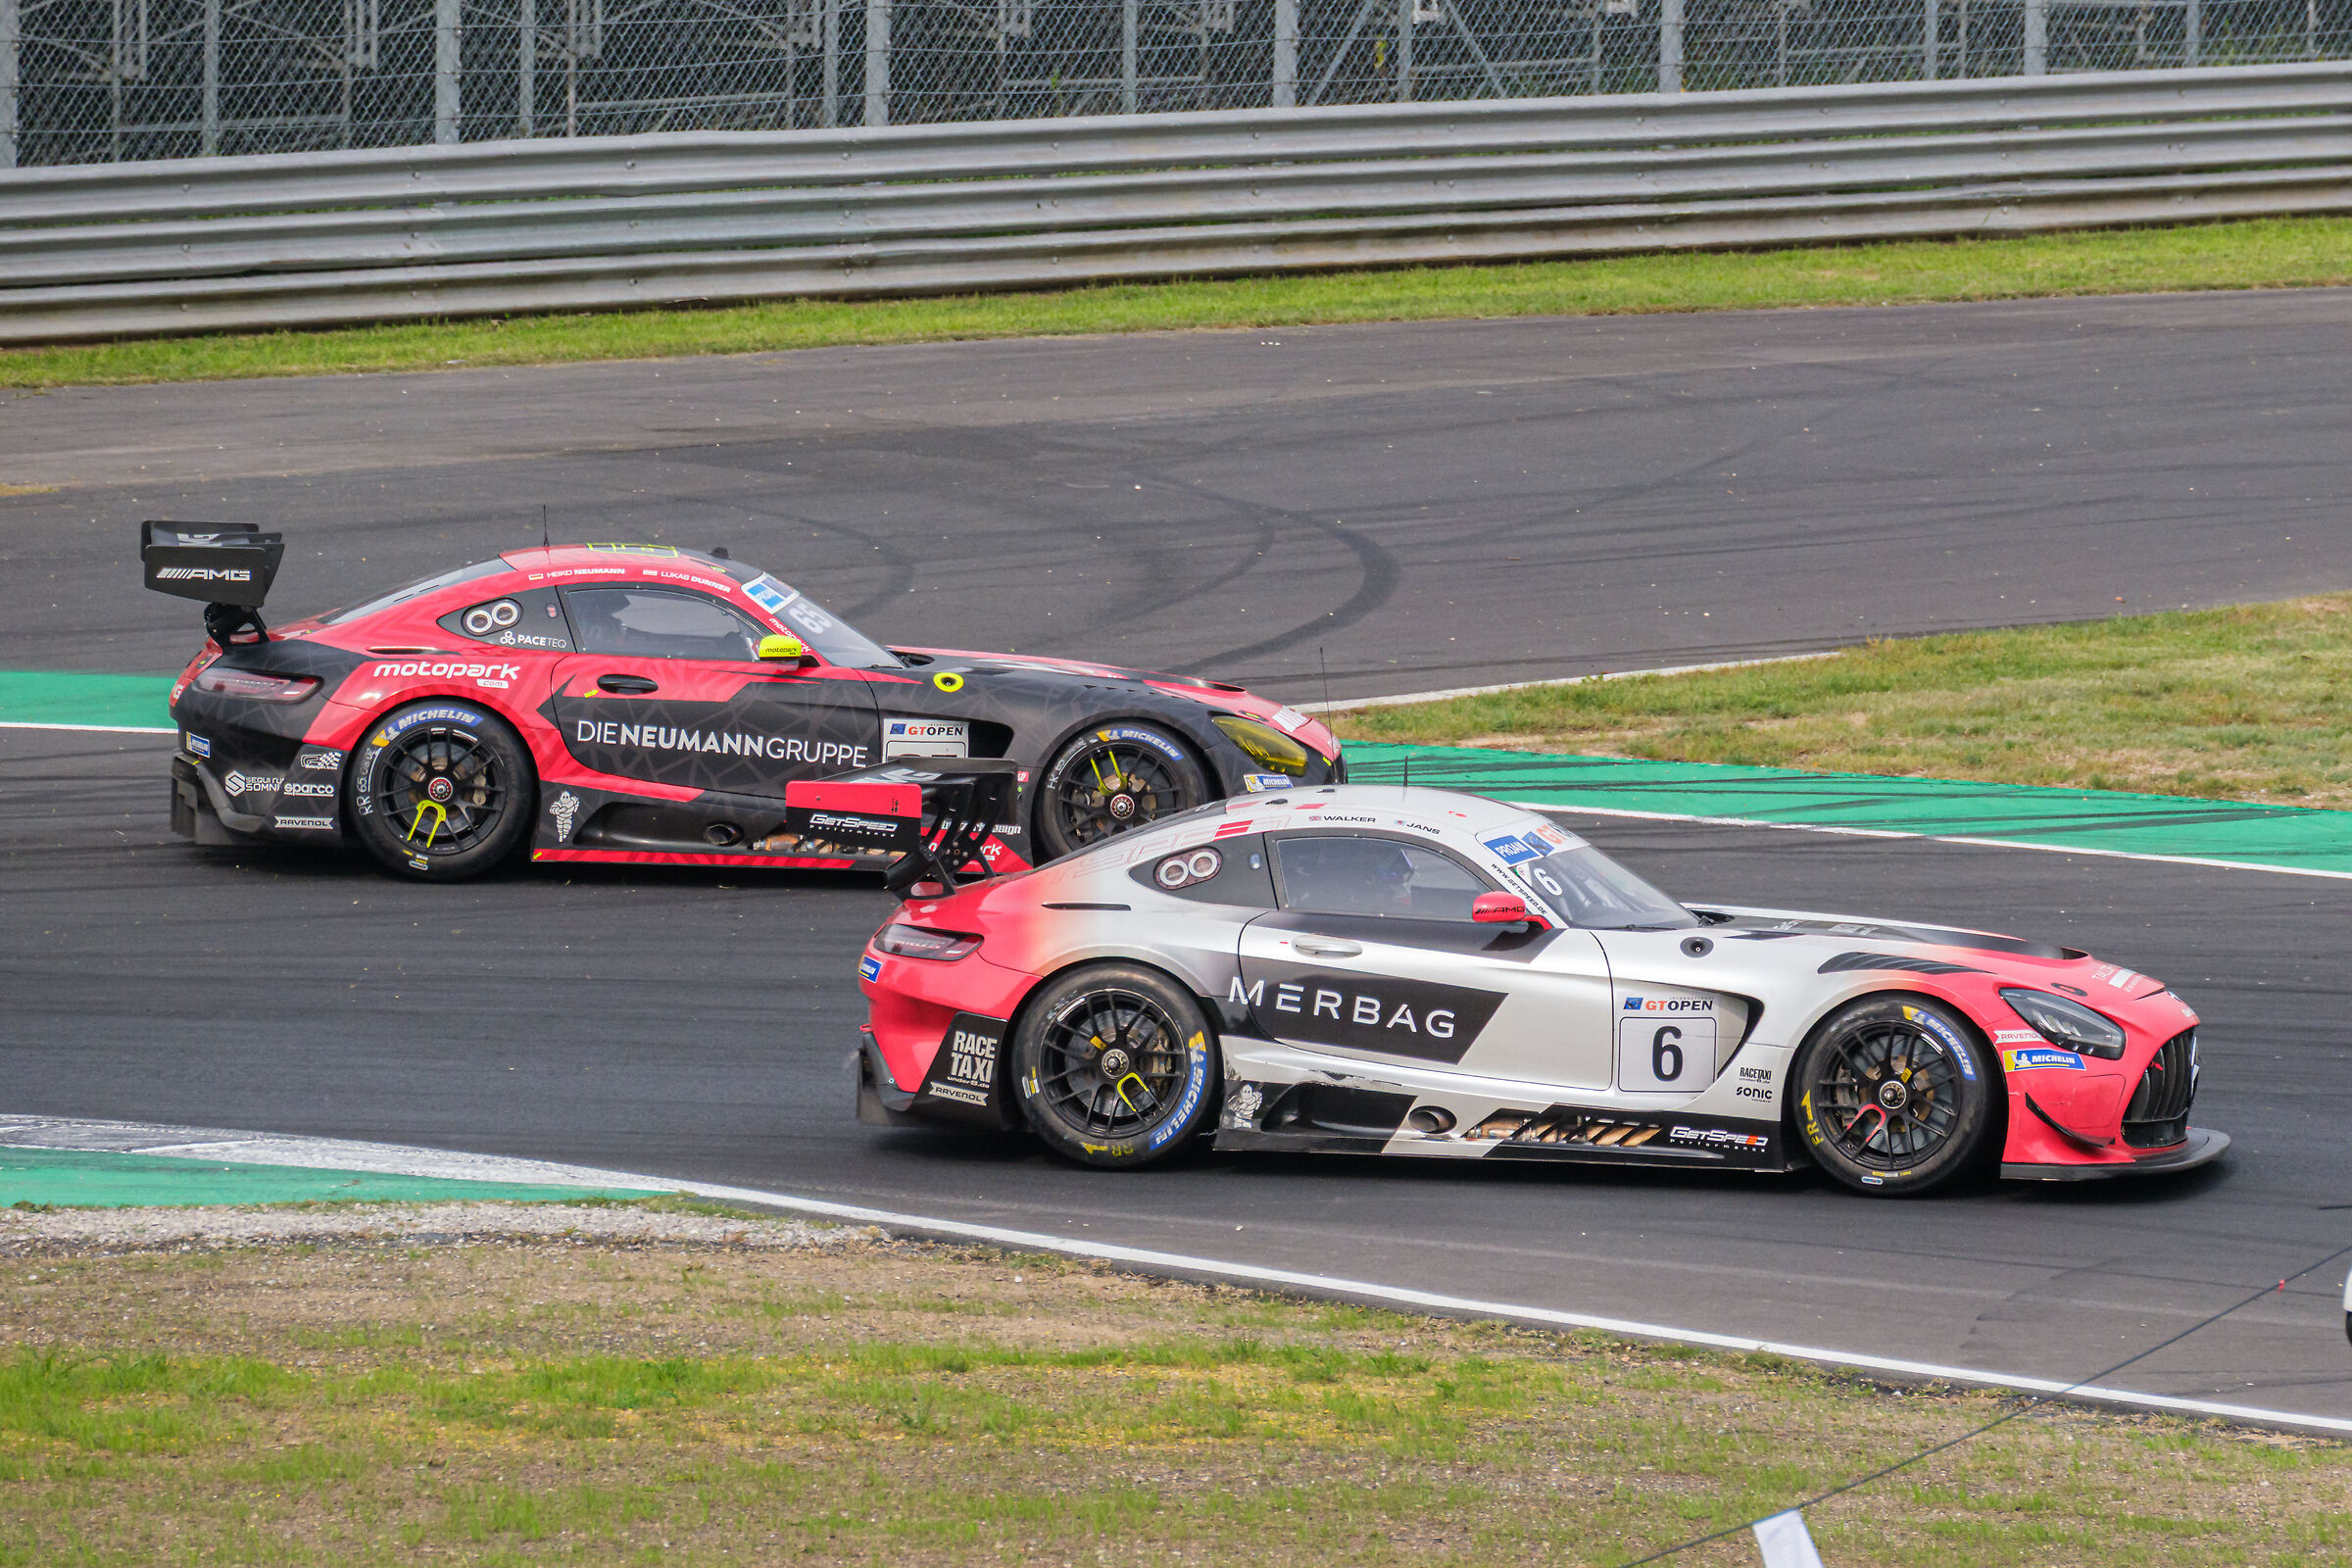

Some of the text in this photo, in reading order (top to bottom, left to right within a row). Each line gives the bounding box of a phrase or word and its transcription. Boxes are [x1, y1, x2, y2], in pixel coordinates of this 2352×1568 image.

[186, 568, 251, 581] AMG
[661, 571, 690, 581] LUKAS
[517, 635, 567, 649] PACETEQ
[373, 661, 521, 680] motopark
[399, 709, 476, 730] MICHELIN
[907, 726, 963, 736] GTOPEN
[1121, 729, 1179, 758] MICHELIN
[283, 783, 335, 797] sparco
[1406, 822, 1441, 835] JANS
[1494, 841, 1530, 858] PROAM
[1534, 867, 1563, 896] 6
[1227, 976, 1456, 1039] MERBAG
[1645, 1000, 1714, 1011] GTOPEN
[953, 1030, 998, 1059] RACE
[1931, 1019, 1974, 1076] MICHELIN
[1652, 1025, 1684, 1082] 6
[2032, 1054, 2076, 1064] MICHELIN
[951, 1052, 995, 1084] TAXI
[1740, 1066, 1772, 1080] RACETAXI
[935, 1087, 983, 1102] RAVENOL
[1155, 1066, 1204, 1145] MICHELIN
